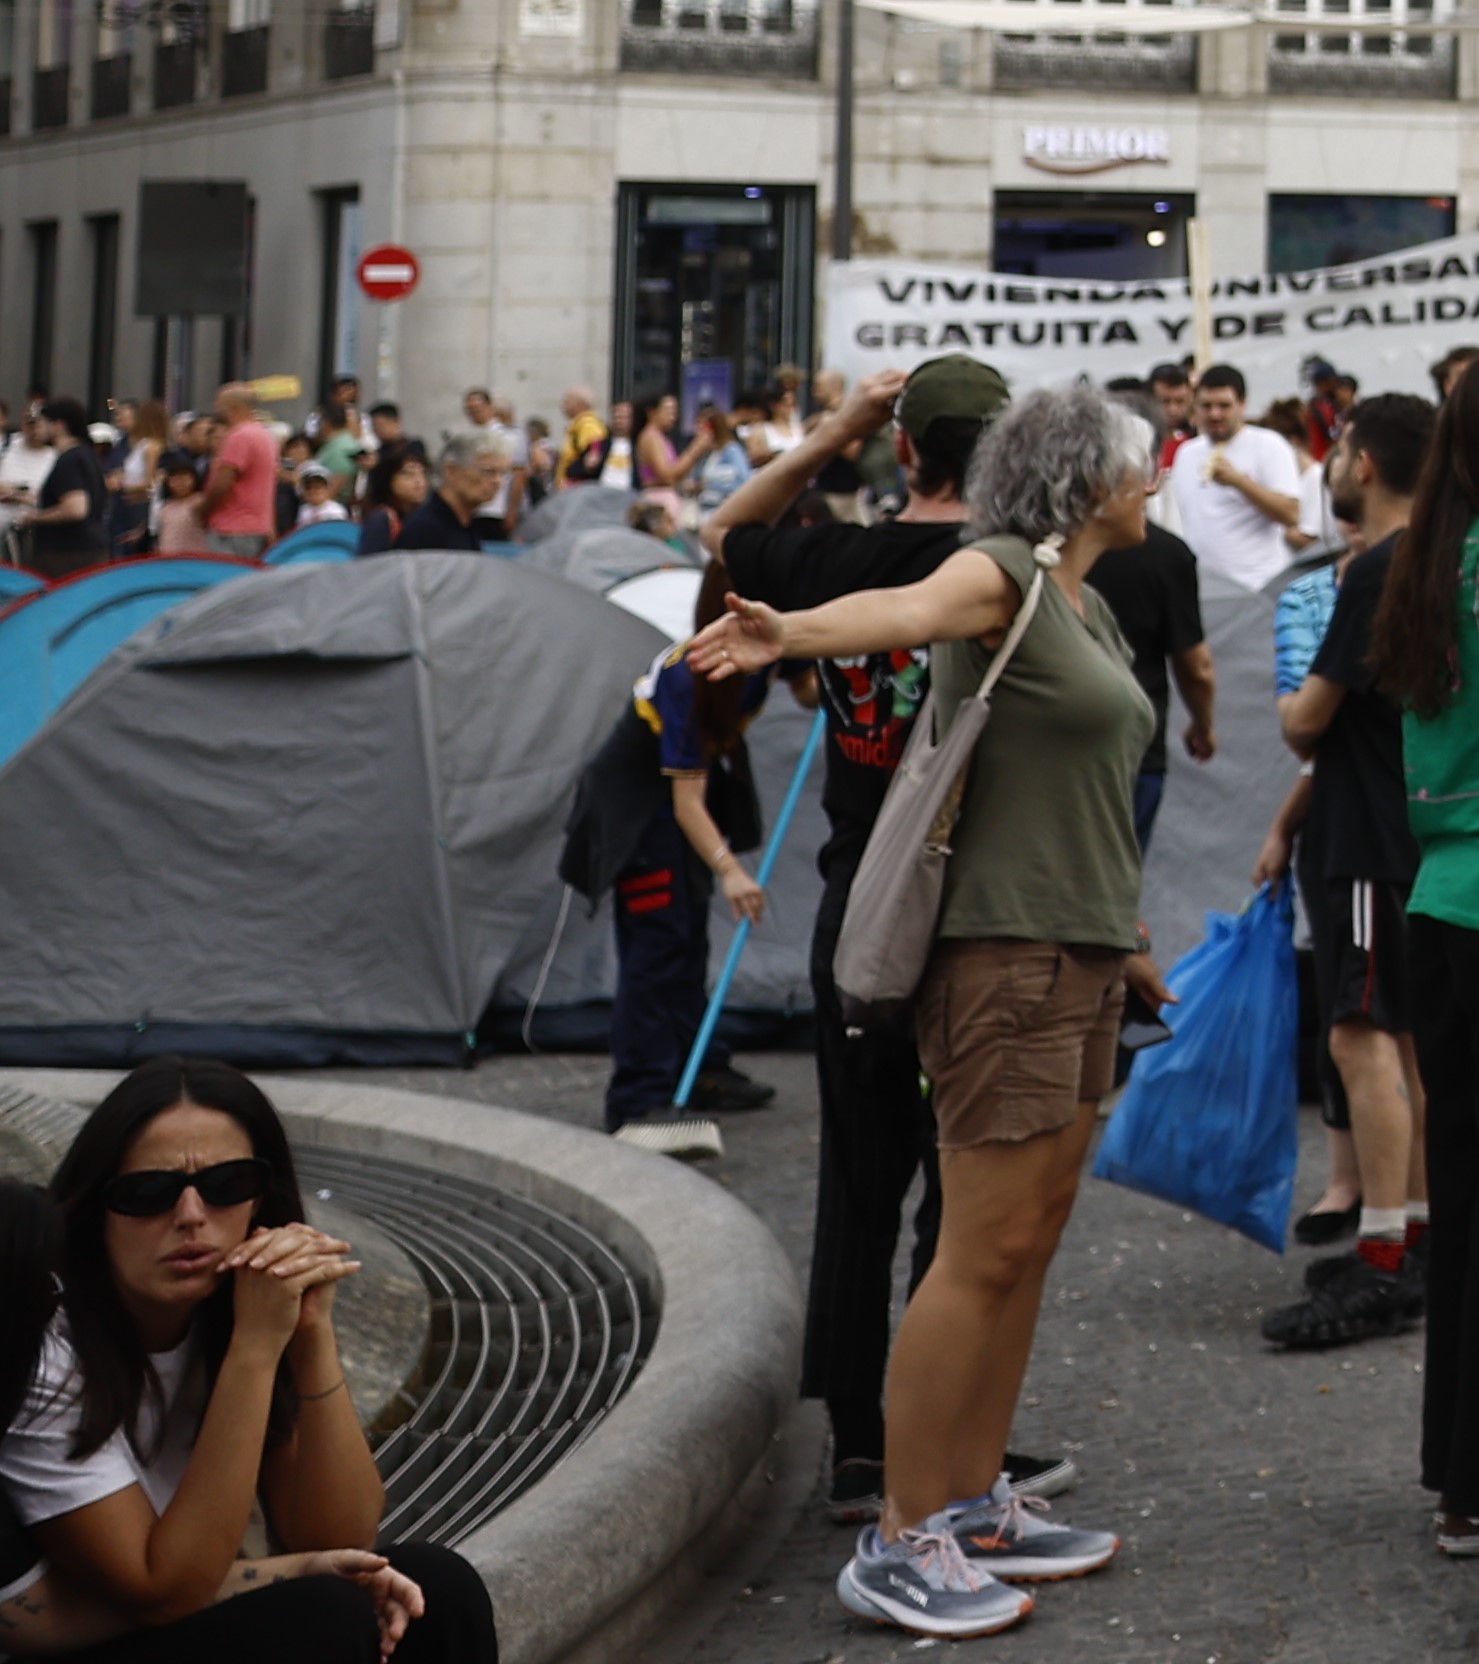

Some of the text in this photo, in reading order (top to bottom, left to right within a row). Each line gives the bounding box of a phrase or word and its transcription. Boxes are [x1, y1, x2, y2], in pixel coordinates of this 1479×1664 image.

[1025, 125, 1171, 160] PRIMOR
[879, 279, 1167, 304] VIVIENDA
[856, 319, 1139, 349] GRATUITA
[1158, 317, 1189, 343] Y
[1213, 312, 1285, 339] DE
